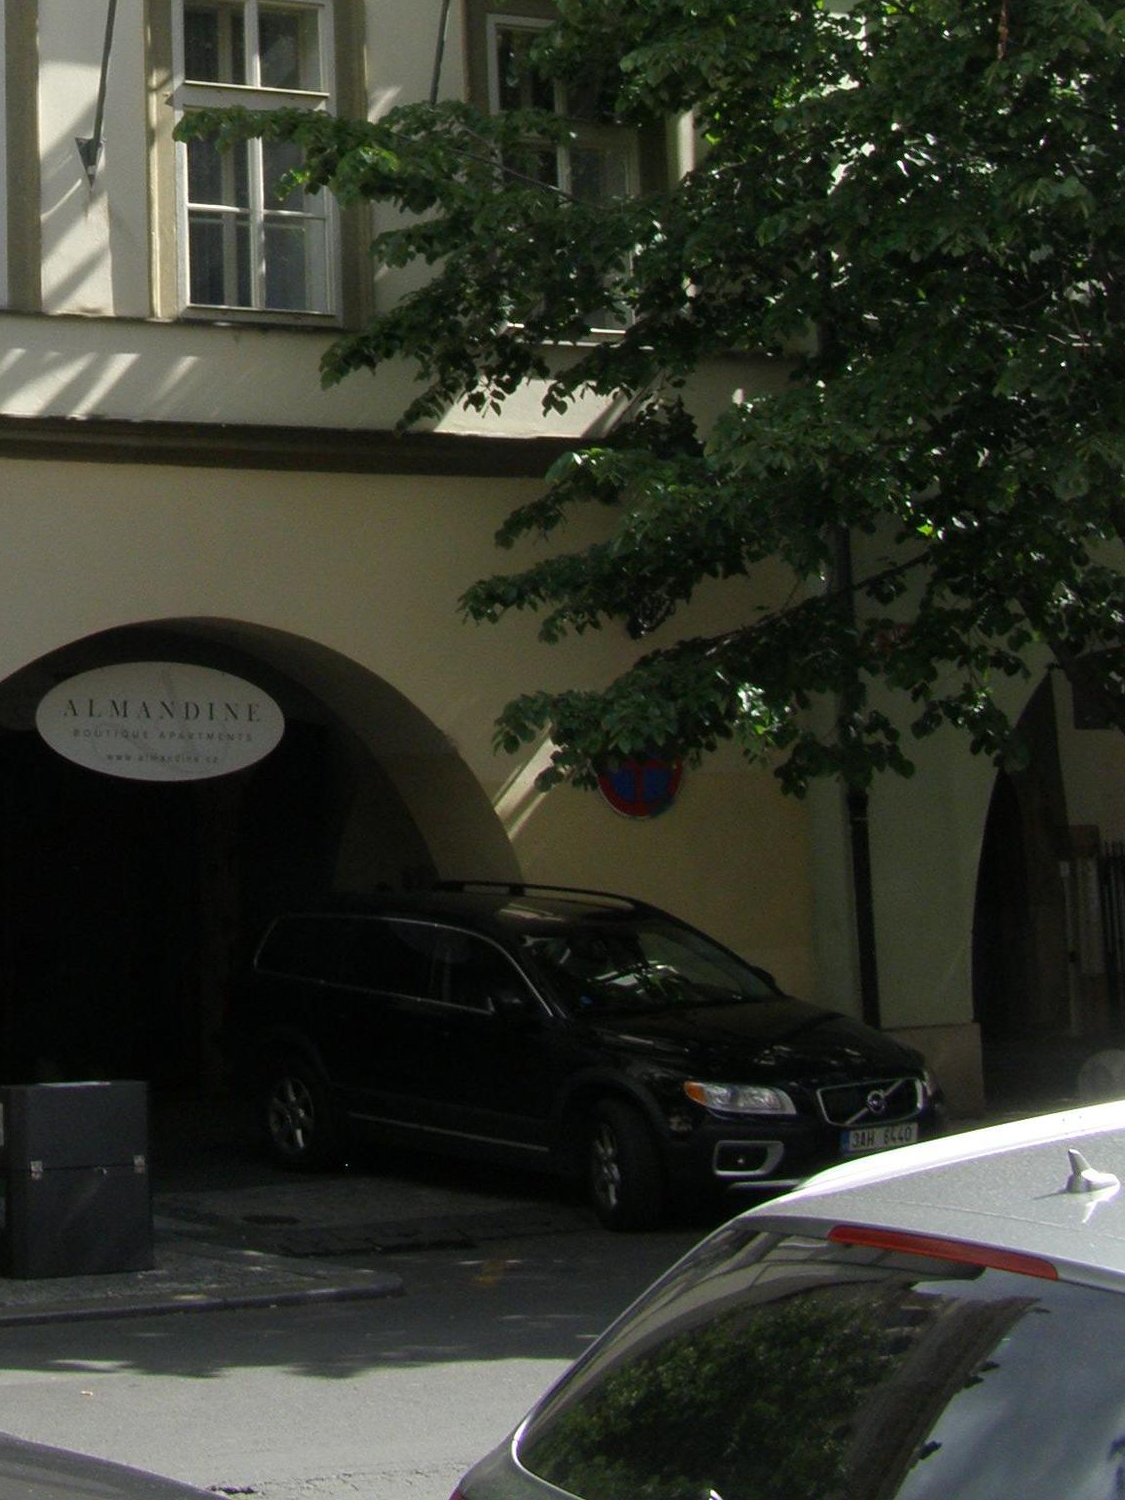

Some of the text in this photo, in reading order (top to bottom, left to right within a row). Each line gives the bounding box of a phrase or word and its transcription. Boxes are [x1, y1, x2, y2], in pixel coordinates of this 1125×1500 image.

[62, 698, 261, 722] ALMANDINE
[72, 728, 253, 742] BOUTIQUE APARTMENTS
[851, 1129, 875, 1148] 3AH
